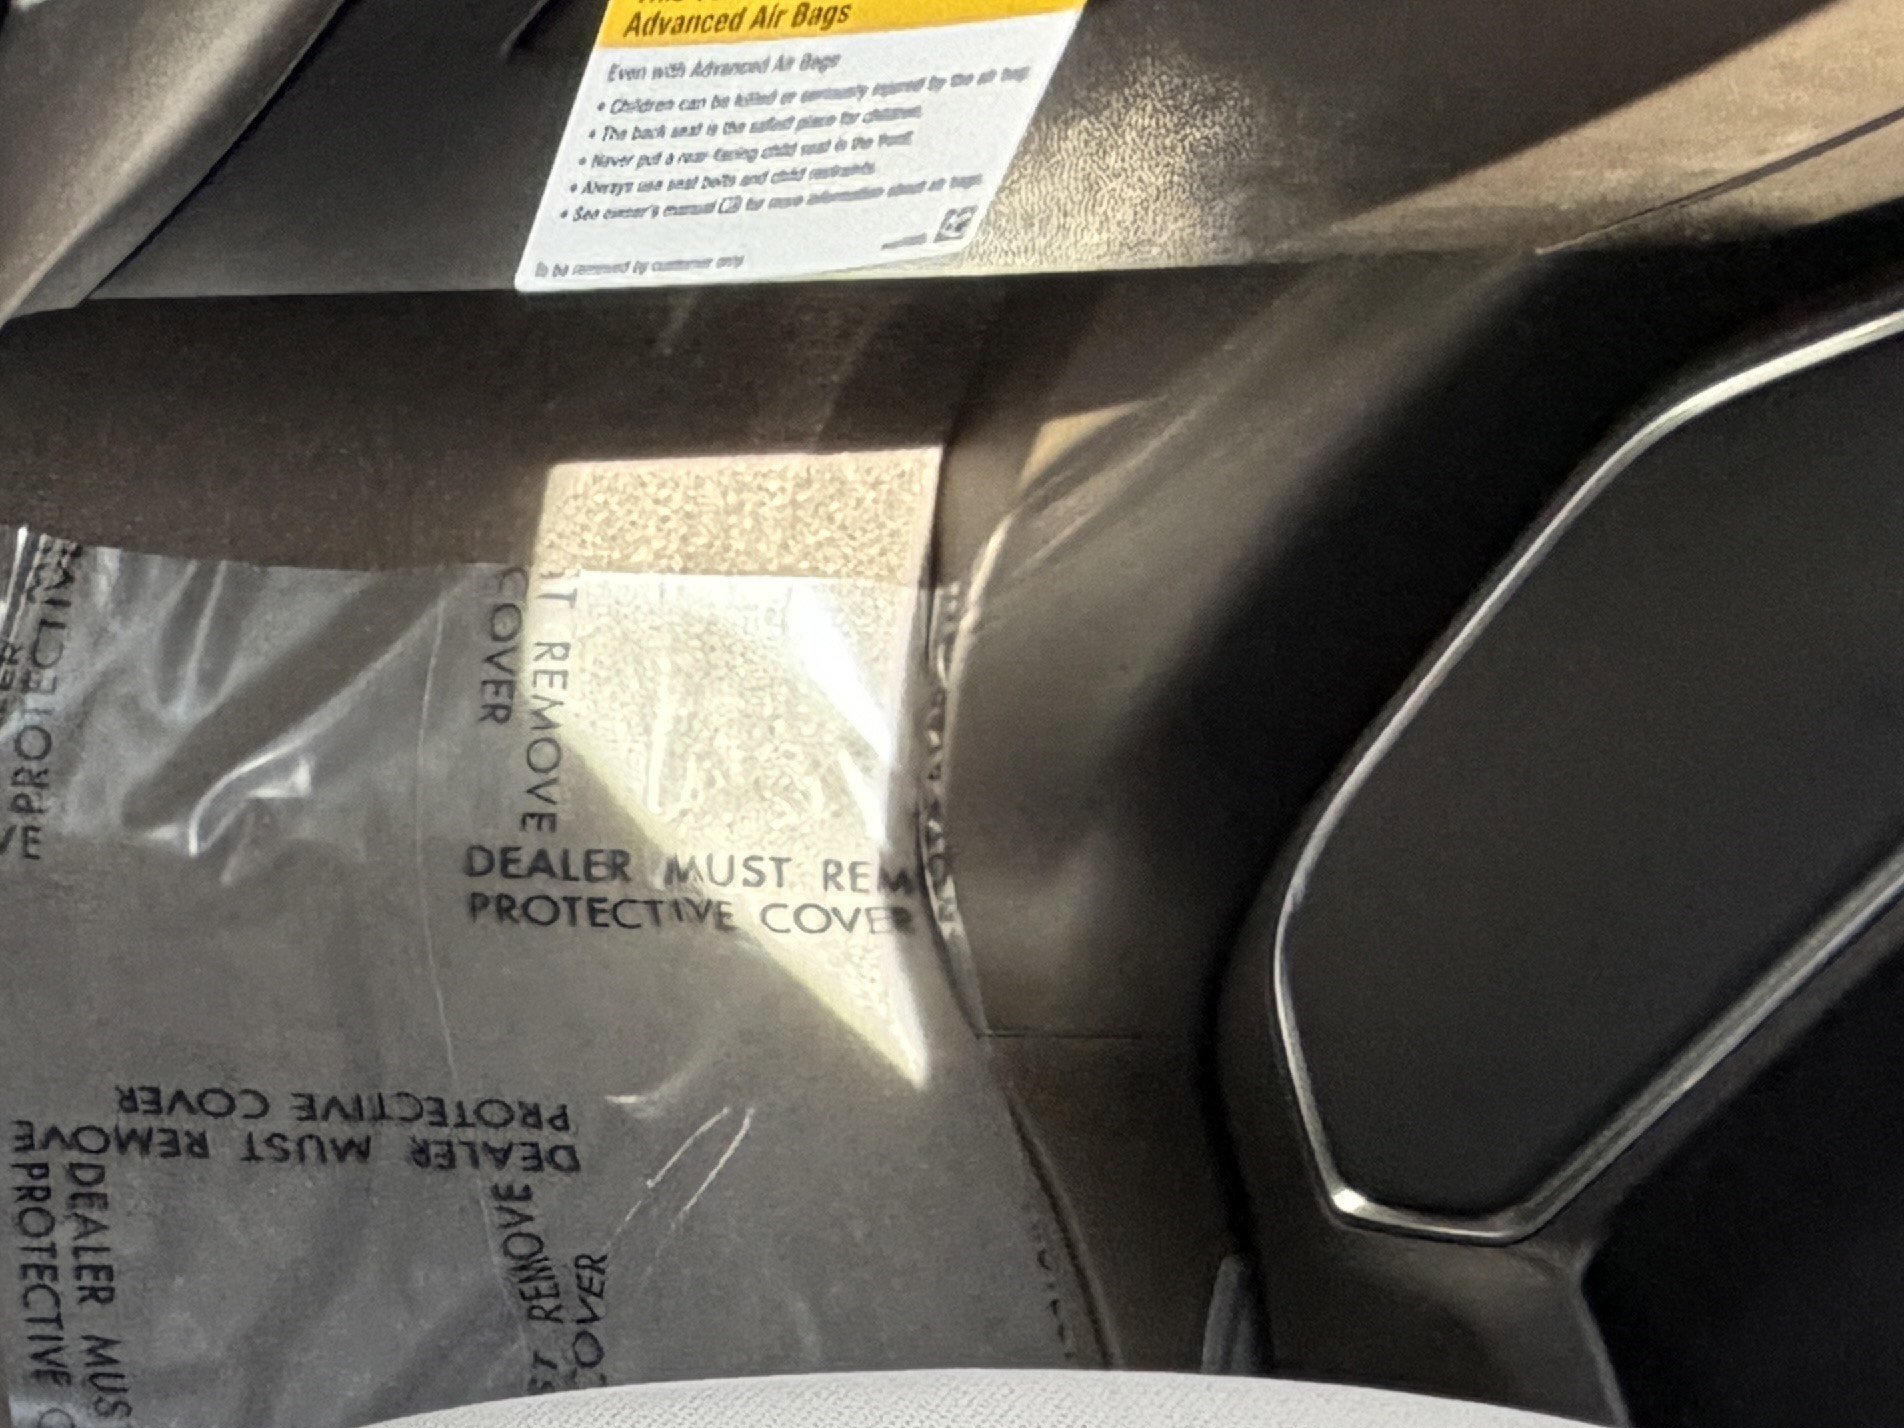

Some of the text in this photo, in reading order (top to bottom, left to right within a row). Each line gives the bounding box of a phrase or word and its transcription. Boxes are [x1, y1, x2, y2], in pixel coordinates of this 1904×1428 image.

[623, 2, 852, 37] Advanced Air Bags
[477, 566, 530, 726] COVER
[519, 641, 572, 833] REMOVE
[464, 843, 632, 885] DEALER
[664, 852, 792, 889] MUST
[467, 891, 916, 937] PROTECTIVE COVER
[10, 1118, 581, 1175] DEALER MUST REMOVE
[113, 1084, 571, 1134] PROTECTIVE COVER
[10, 1161, 72, 1389] PROTECTIVE
[67, 1161, 116, 1306] DEALER
[491, 1182, 565, 1324] REMOVE
